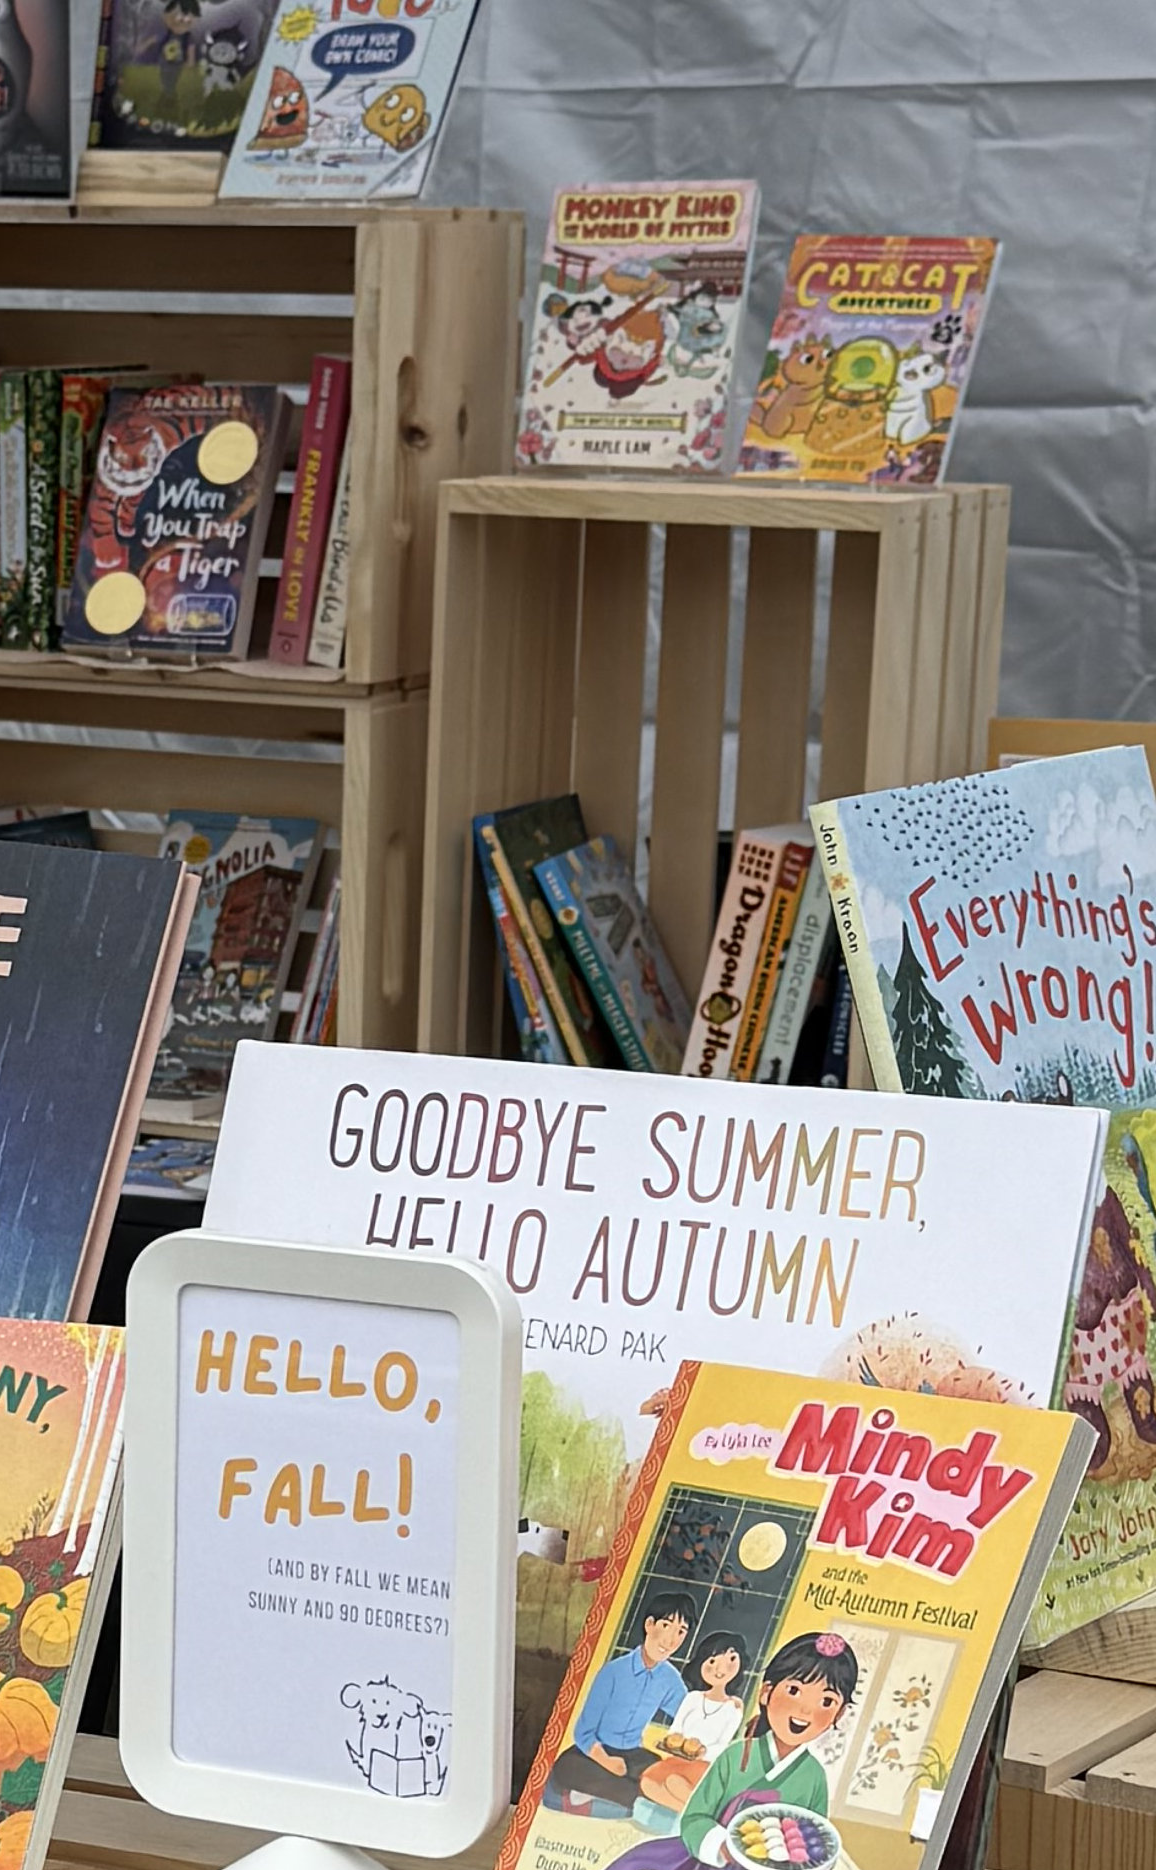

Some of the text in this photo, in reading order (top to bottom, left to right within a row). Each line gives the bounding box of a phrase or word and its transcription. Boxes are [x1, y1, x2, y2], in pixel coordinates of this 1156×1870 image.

[325, 49, 353, 64] OWN
[564, 195, 736, 221] MONKEY KING
[582, 223, 638, 238] WORLD
[645, 222, 664, 237] OF
[669, 221, 729, 236] MYTHS
[797, 262, 978, 310] CAT&CAT
[144, 396, 243, 408] TAE KELLER
[158, 478, 225, 510] When
[296, 449, 322, 543] FRANKLY
[29, 477, 46, 605] Seed Sun
[142, 512, 246, 549] You Trap
[157, 542, 240, 590] a Tiger
[284, 573, 302, 622] LOVE
[819, 823, 838, 866] John
[717, 885, 765, 992] Dragon
[908, 864, 1156, 982] Everything's
[775, 914, 819, 1046] displacement
[961, 959, 1154, 1089] Wrong!
[329, 1083, 927, 1232] GOODBYE SUMMER,
[573, 1216, 860, 1328] AUTUMN
[621, 1329, 667, 1363] PAK
[196, 1330, 441, 1423] HELLO,
[775, 1402, 1032, 1530] Mindy
[218, 1453, 413, 1538] FALL!
[816, 1475, 976, 1576] Kim
[1070, 1505, 1156, 1561] Jory John
[267, 1558, 451, 1600] (AND BY FALL WE MEAN
[822, 1565, 869, 1585] and the
[248, 1592, 359, 1624] SUNNY AND 90
[804, 1582, 978, 1631] Mid-Autumn Festival
